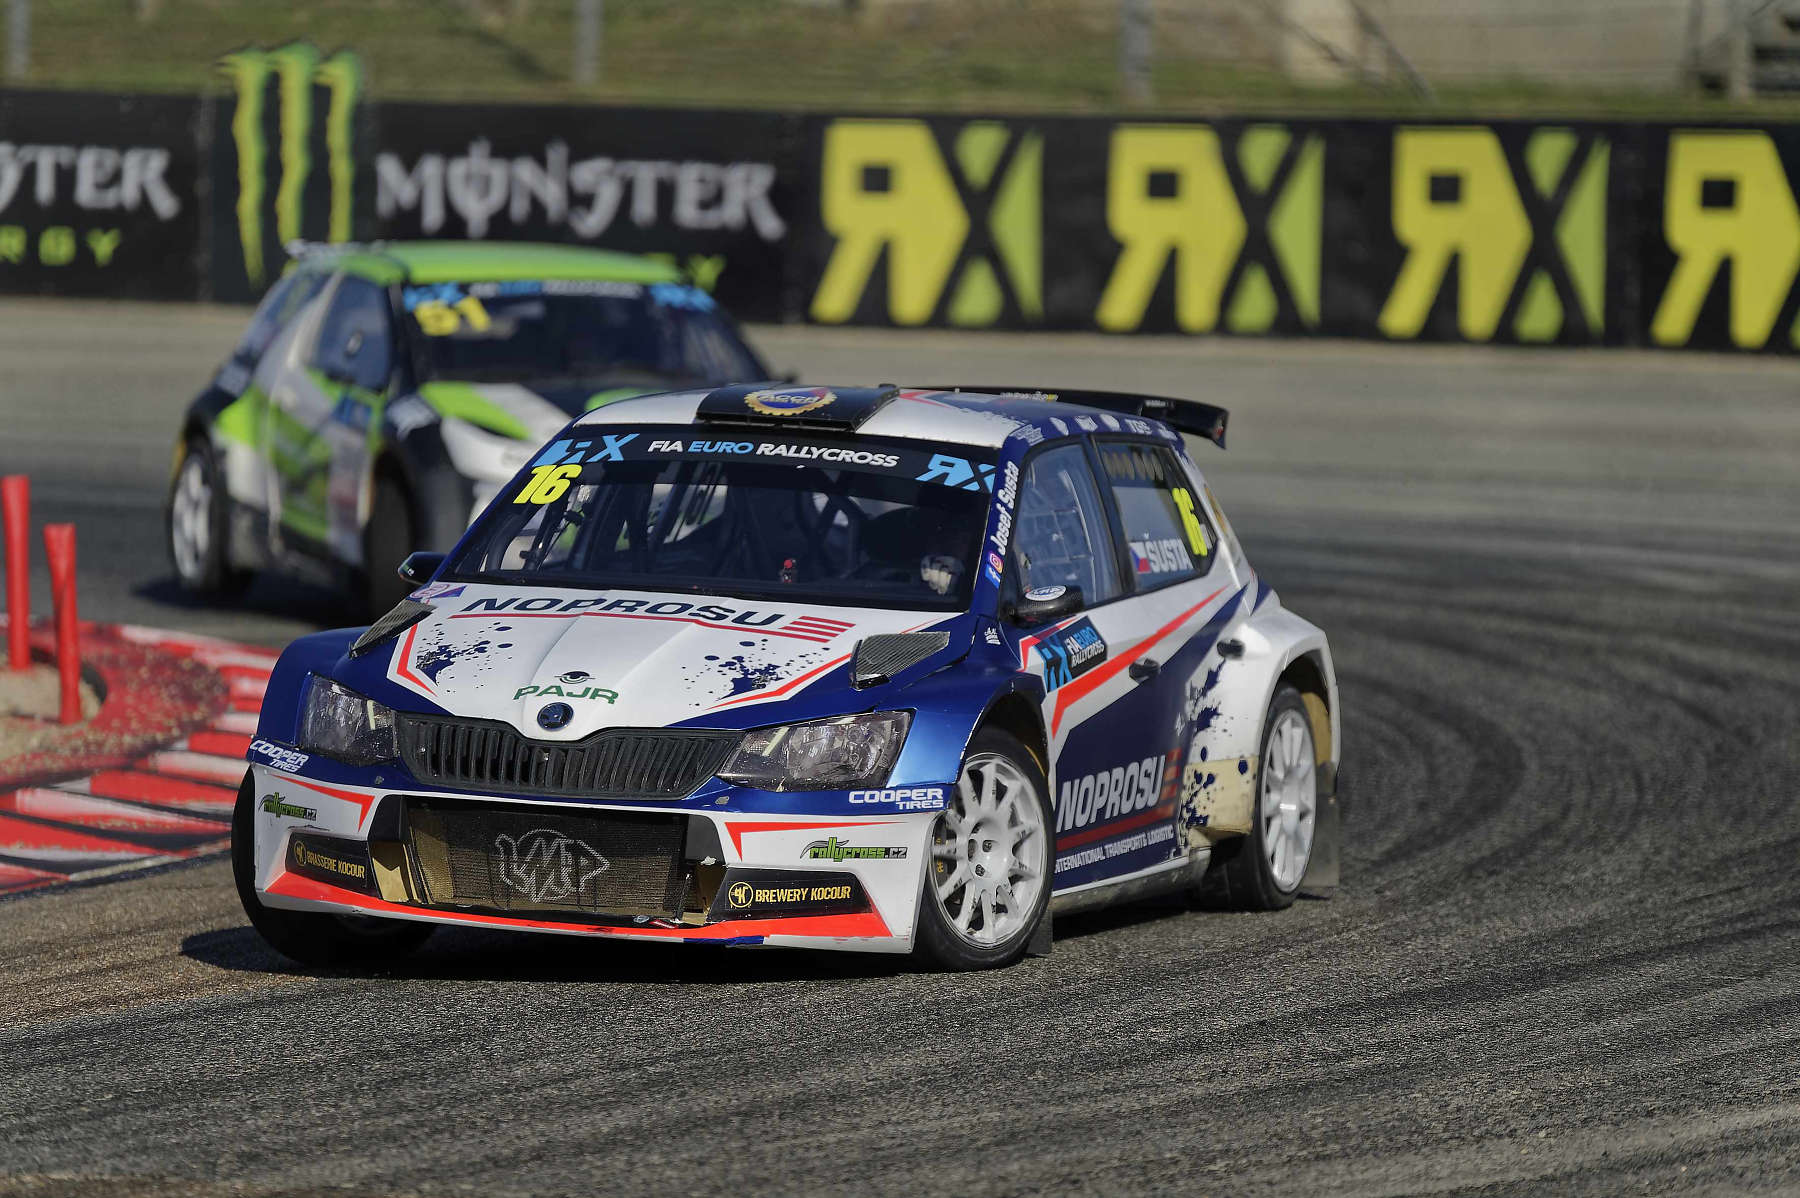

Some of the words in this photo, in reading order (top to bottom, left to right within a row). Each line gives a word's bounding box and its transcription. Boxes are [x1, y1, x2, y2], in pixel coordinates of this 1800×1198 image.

[374, 138, 786, 242] MONSTER
[647, 440, 683, 453] FIA
[687, 440, 755, 454] EURO
[755, 443, 900, 468] RALLYCROSS
[512, 464, 583, 505] 16
[990, 503, 1012, 555] Josef
[1172, 488, 1208, 556] 16
[459, 597, 787, 627] NOPROSU
[513, 684, 620, 705] PAJR
[249, 740, 310, 766] COOPER
[269, 758, 301, 773] TIRES
[848, 788, 944, 804] COOPER
[896, 800, 944, 810] TIRES
[1056, 755, 1166, 833] NOPROSU
[809, 836, 908, 862] rallycross.cz
[306, 851, 337, 872] BRASSERIE
[338, 860, 365, 879] KOCOUR
[755, 887, 809, 903] BREWERY
[810, 885, 852, 901] KOCOUR
